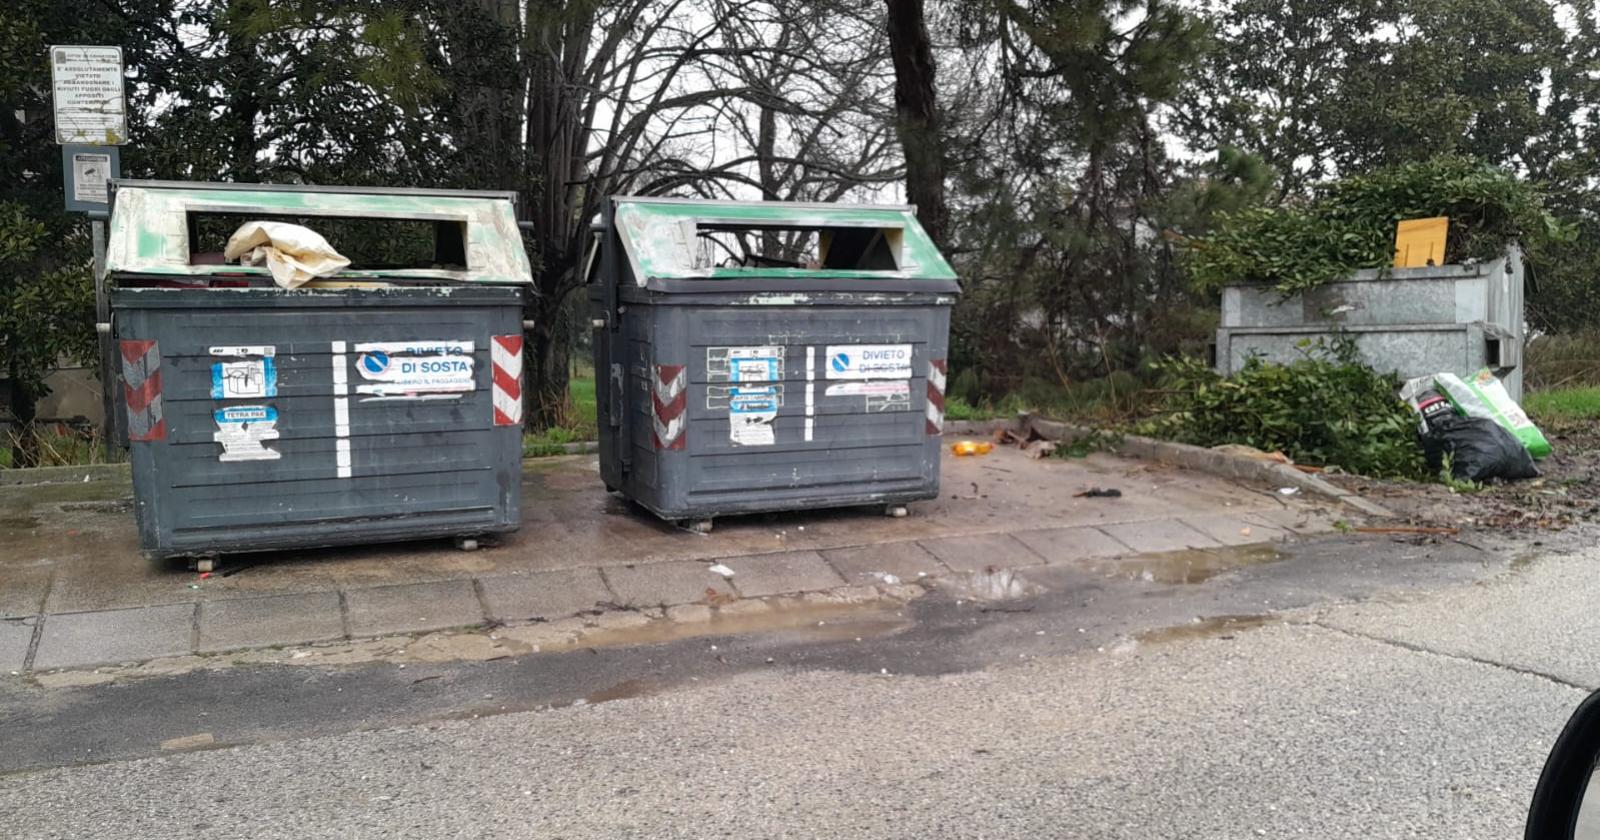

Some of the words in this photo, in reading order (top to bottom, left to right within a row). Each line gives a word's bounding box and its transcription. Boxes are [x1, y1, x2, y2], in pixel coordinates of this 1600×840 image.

[863, 350, 905, 360] DIVIETO
[401, 362, 416, 373] DI
[420, 361, 468, 373] SOSTA
